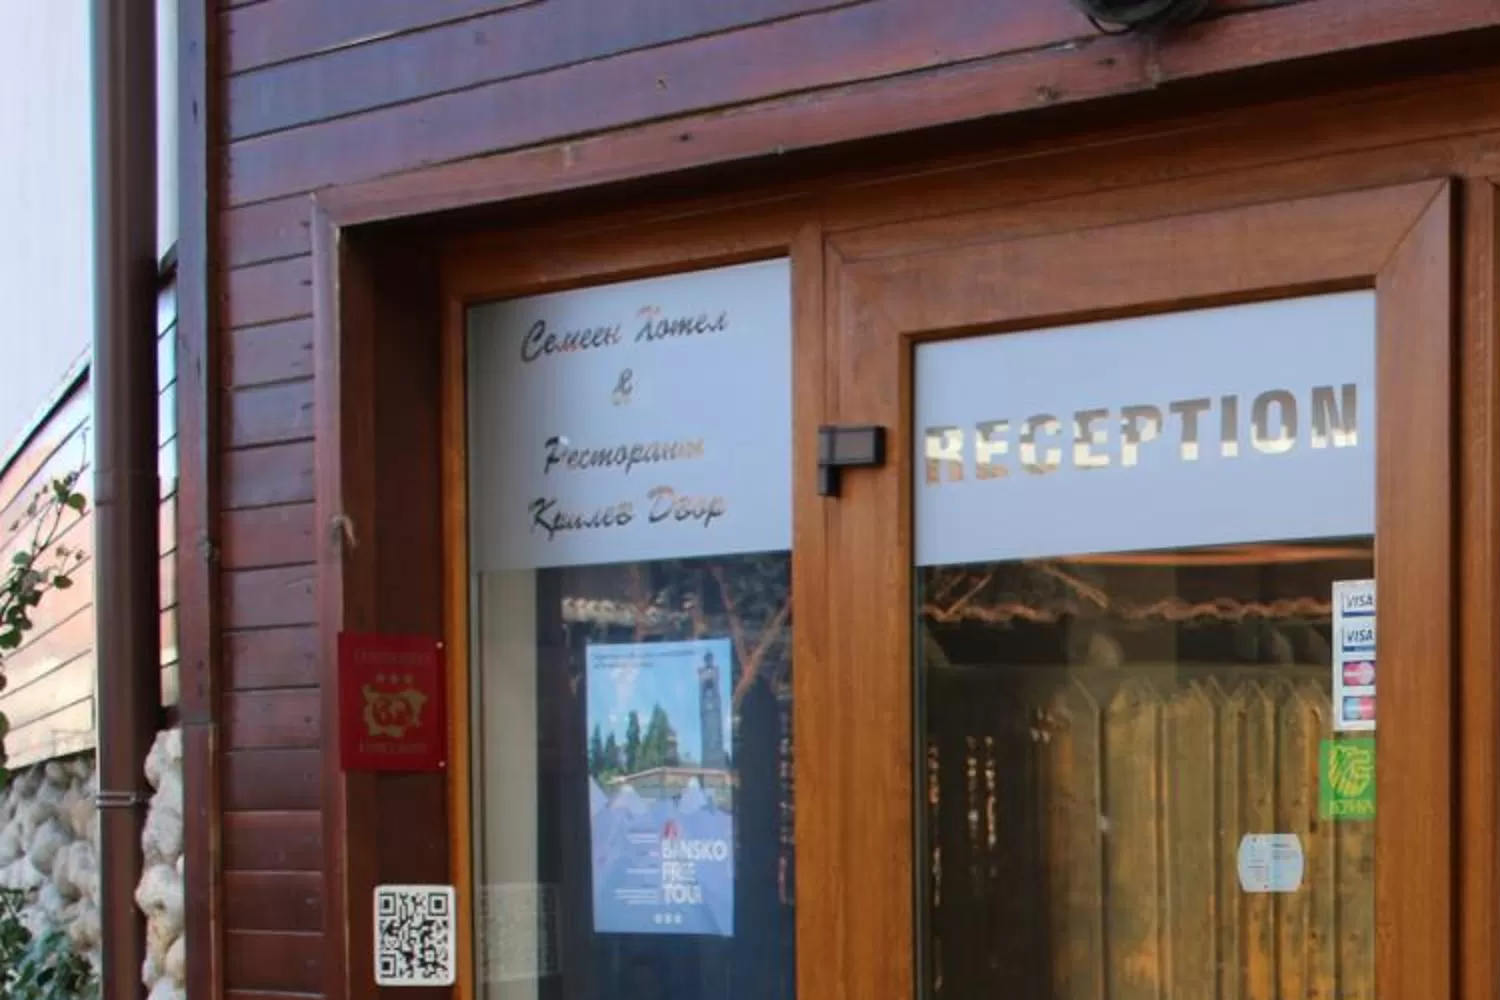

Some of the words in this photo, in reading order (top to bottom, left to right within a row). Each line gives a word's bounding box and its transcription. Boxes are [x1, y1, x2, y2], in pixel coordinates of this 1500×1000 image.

[924, 383, 1358, 486] RECEPTION
[1347, 592, 1373, 608] VISA
[1347, 629, 1373, 643] VISA
